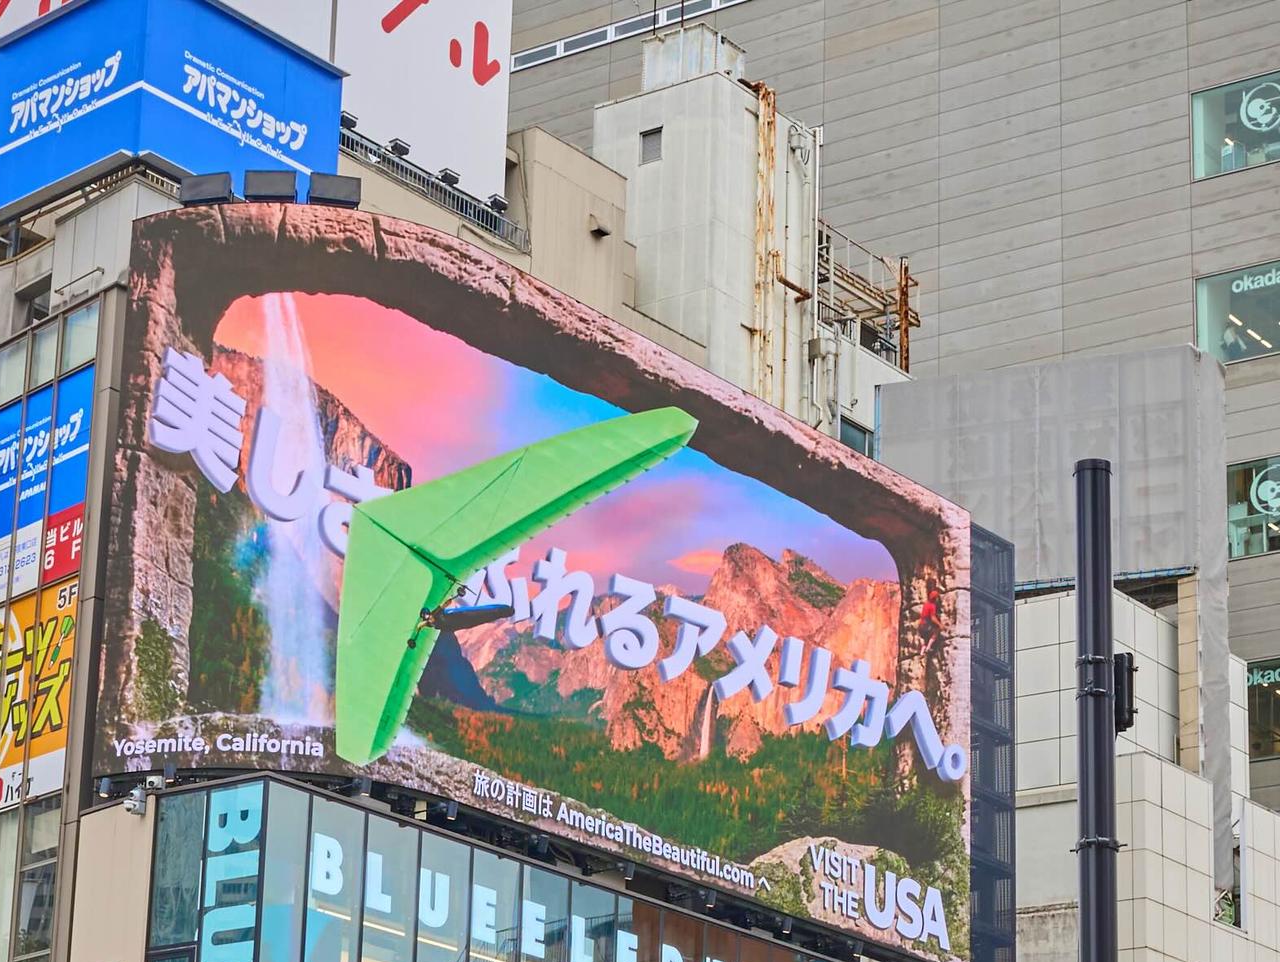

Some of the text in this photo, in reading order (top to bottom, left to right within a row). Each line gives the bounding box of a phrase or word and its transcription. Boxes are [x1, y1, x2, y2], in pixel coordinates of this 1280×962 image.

[9, 51, 122, 134] アパマンショップ
[183, 64, 308, 152] アパマンショップ
[46, 518, 83, 549] 当ビル
[57, 583, 79, 610] 5F
[114, 734, 324, 758] Yosemite, California
[474, 770, 553, 819] 旅の計画は
[557, 802, 754, 888] AmericaTheBeautiful.com
[810, 844, 860, 884] VISIT
[820, 880, 859, 920] THE
[861, 864, 951, 951] USA
